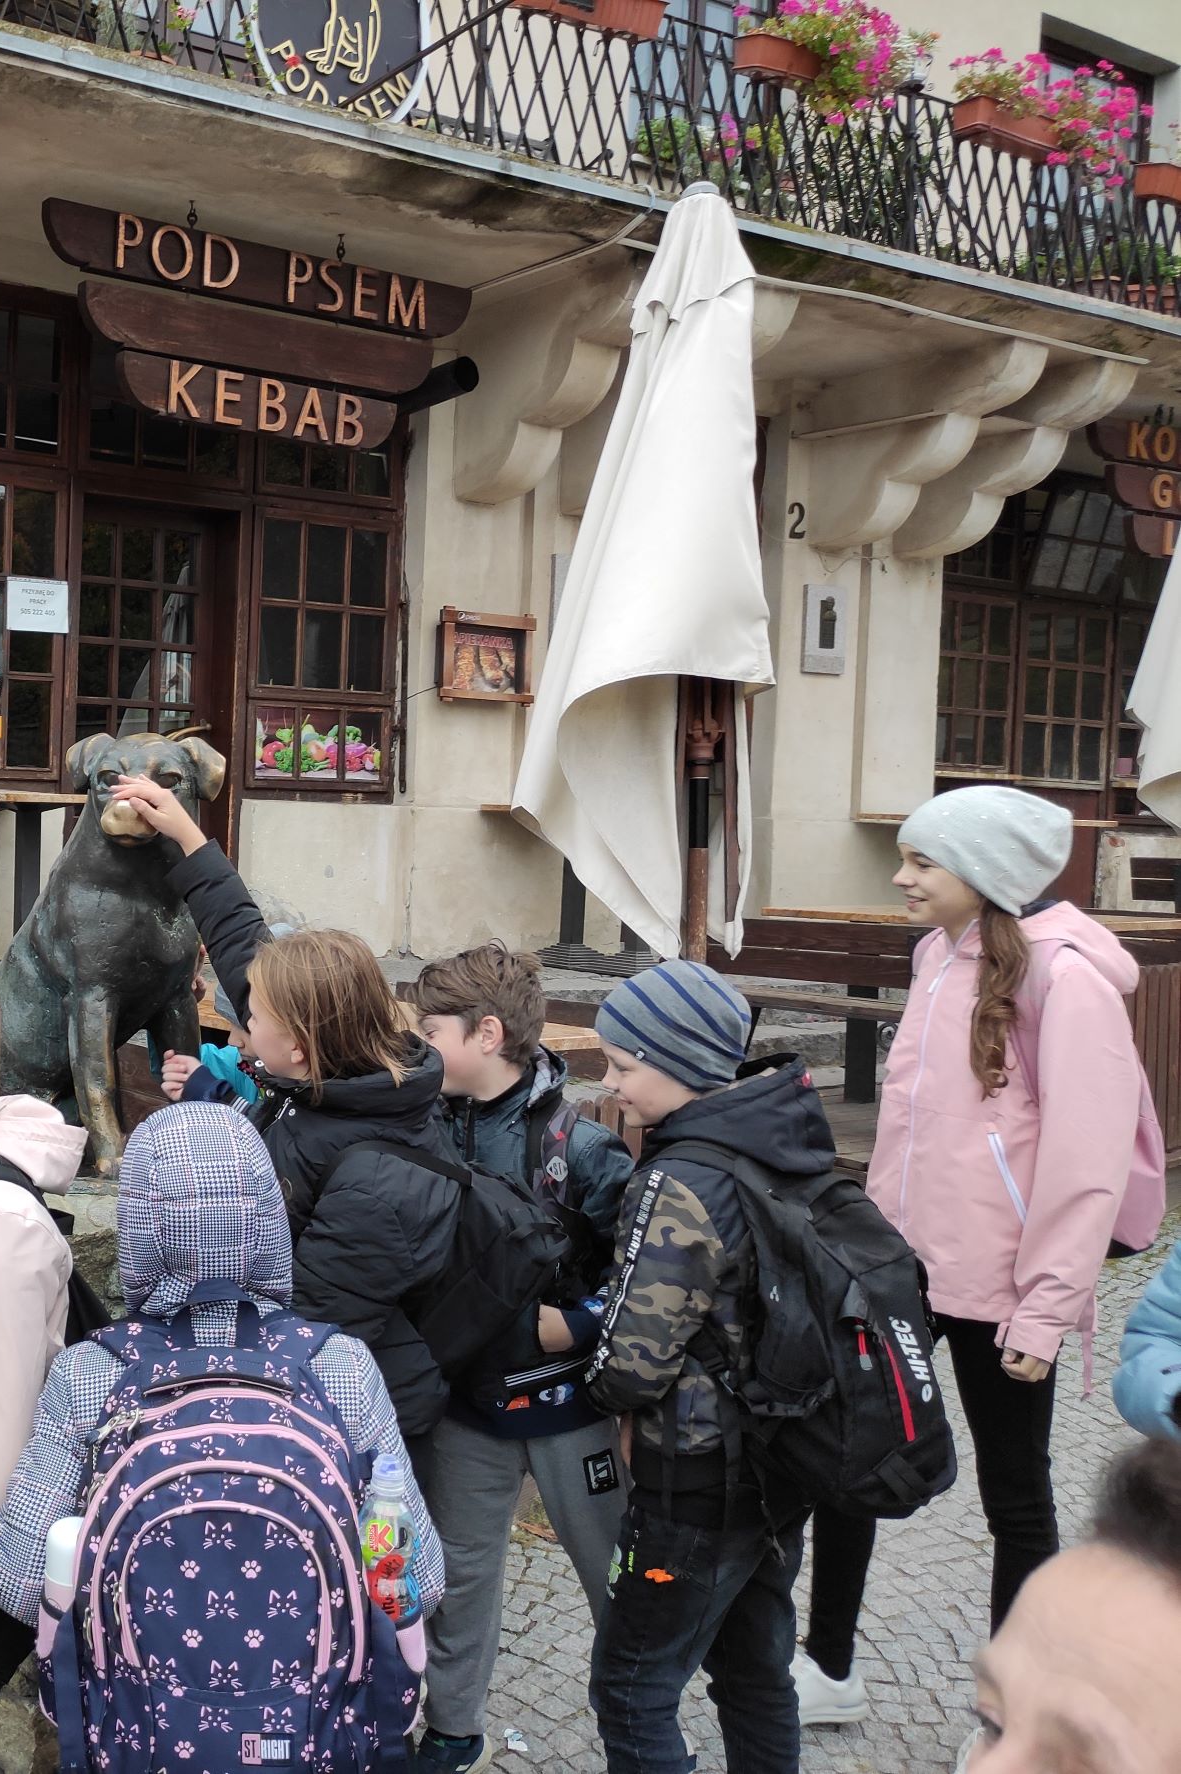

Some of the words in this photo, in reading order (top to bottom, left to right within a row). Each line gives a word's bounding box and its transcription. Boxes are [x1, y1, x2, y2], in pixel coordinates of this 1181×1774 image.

[115, 213, 240, 289] POD
[286, 251, 426, 330] PSEM
[168, 359, 364, 448] KEBAB
[1127, 421, 1181, 463] KO
[1152, 473, 1181, 509] G
[788, 502, 807, 539] 2
[626, 1227, 644, 1261] SKATE
[891, 1319, 931, 1382] HI-TEC
